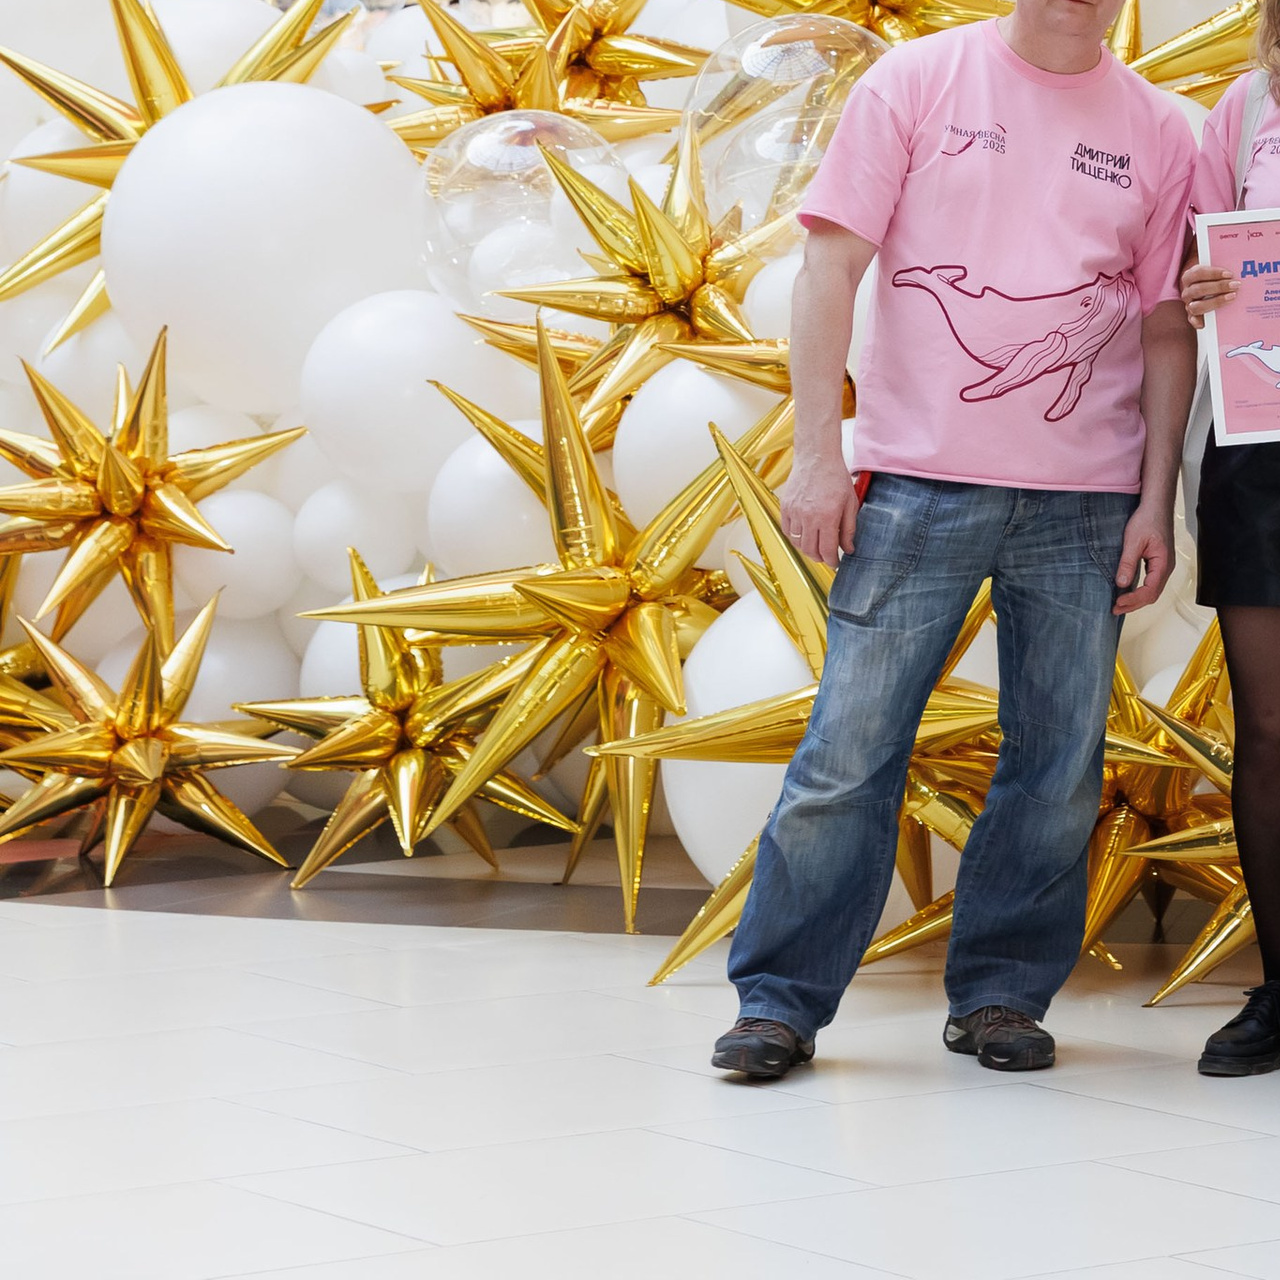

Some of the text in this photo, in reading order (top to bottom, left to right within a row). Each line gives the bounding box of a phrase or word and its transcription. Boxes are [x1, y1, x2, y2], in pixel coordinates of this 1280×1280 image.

[977, 130, 1006, 144] ВЕСНА
[983, 139, 1006, 155] 2025
[1074, 142, 1131, 171] ДМИТРИЙ
[1070, 156, 1132, 189] ТИЩЕНКО
